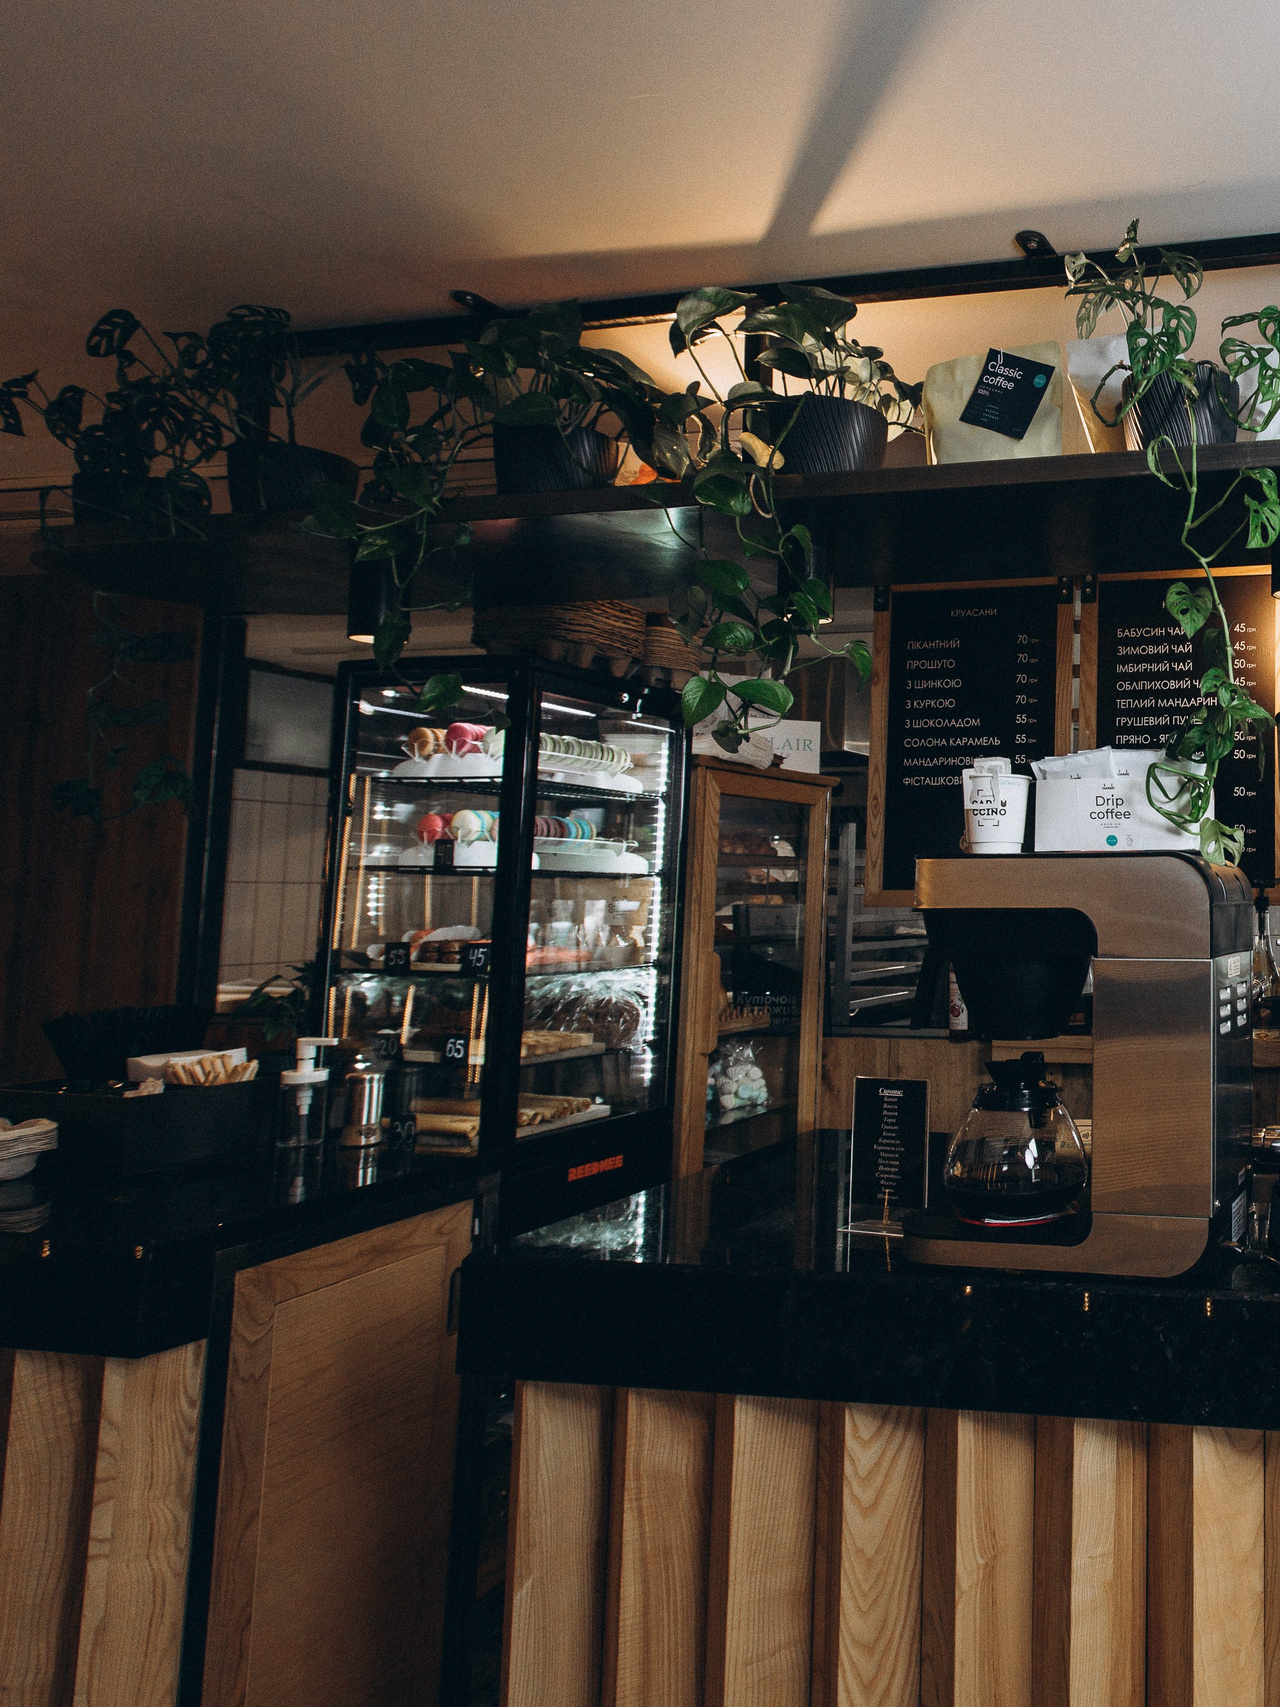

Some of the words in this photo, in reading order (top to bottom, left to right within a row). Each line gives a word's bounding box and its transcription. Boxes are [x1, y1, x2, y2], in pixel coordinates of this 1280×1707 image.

[988, 360, 1023, 379] Classic
[982, 375, 1015, 390] coffee
[950, 608, 997, 618] КРУАСАНИ
[1117, 627, 1165, 638] БАБУСИН
[1233, 623, 1246, 633] 45
[907, 638, 960, 650] ПІКАНТНИЙ
[1016, 634, 1028, 644] 70
[1117, 642, 1169, 655] ЗИМОВИЙ
[1171, 642, 1193, 653] ЧАЙ
[1233, 641, 1246, 651] 45
[906, 659, 956, 670] ПРОШУТО
[1016, 653, 1028, 663] 70
[1116, 661, 1169, 673] ІМБИРНИЙ
[1171, 660, 1193, 671] ЧАЙ
[1233, 659, 1246, 669] 50
[914, 678, 962, 689] ШИНКОЮ
[1016, 674, 1027, 684] 70
[1116, 678, 1190, 691] ОБЛІПИХОВИЙ
[1234, 677, 1246, 687] 45
[913, 698, 956, 709] КУРКОЮ
[1015, 695, 1027, 704] 70
[1116, 697, 1155, 709] ТЕПЛИЙ
[1157, 696, 1218, 708] МАНДАРИН
[912, 718, 981, 728] ШОКОЛАДОМ
[1015, 714, 1027, 724] 55
[1116, 714, 1170, 727] ГРУШЕВИЙ
[904, 738, 948, 748] СОЛОНА
[949, 736, 1001, 746] КАРАМЕЛЬ
[1014, 734, 1026, 744] 55
[1115, 734, 1151, 745] ПРЯНО
[1233, 731, 1246, 741] 50
[1014, 754, 1026, 764] 55
[1233, 749, 1246, 759] 50
[1233, 787, 1246, 797] 50
[1095, 794, 1124, 808] Drip
[972, 808, 1007, 816] CCINO
[1089, 809, 1131, 820] coffee
[468, 948, 487, 967] 45
[379, 1039, 399, 1056] 20
[445, 1038, 465, 1059] 65
